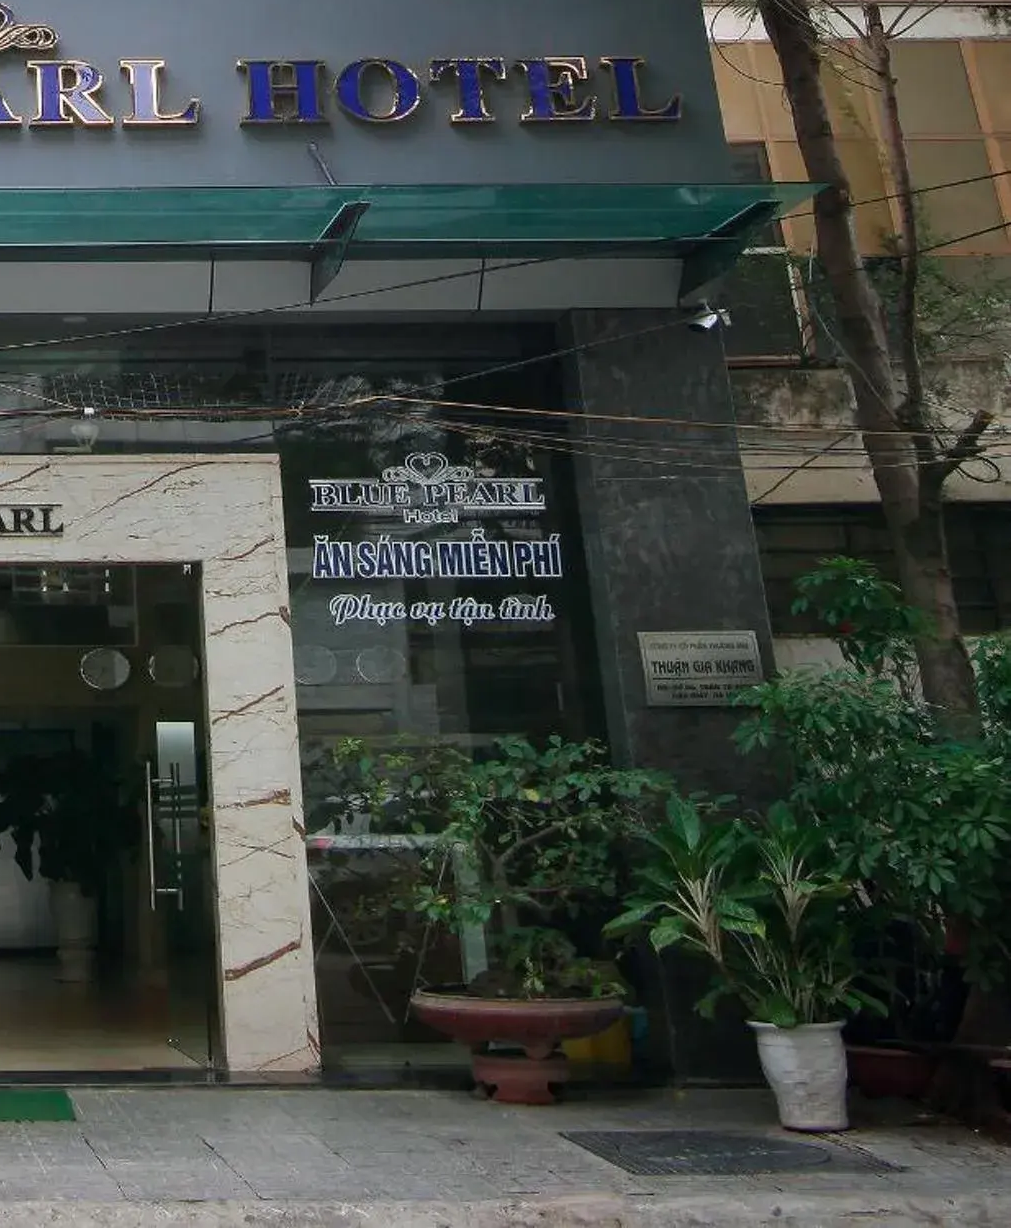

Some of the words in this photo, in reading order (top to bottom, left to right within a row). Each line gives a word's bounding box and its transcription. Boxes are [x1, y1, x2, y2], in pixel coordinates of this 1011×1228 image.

[236, 55, 682, 129] HOTEL
[310, 482, 411, 507] BLUE
[422, 481, 545, 506] PEARL
[402, 508, 459, 524] Hotel
[312, 535, 354, 579] ĂN
[357, 535, 434, 579] SÁNG
[435, 528, 511, 579] MIỄN
[513, 533, 564, 579] PHÍ
[329, 593, 407, 626] Phục
[409, 601, 446, 626] vụ
[449, 597, 496, 626] tận
[497, 593, 556, 620] tình
